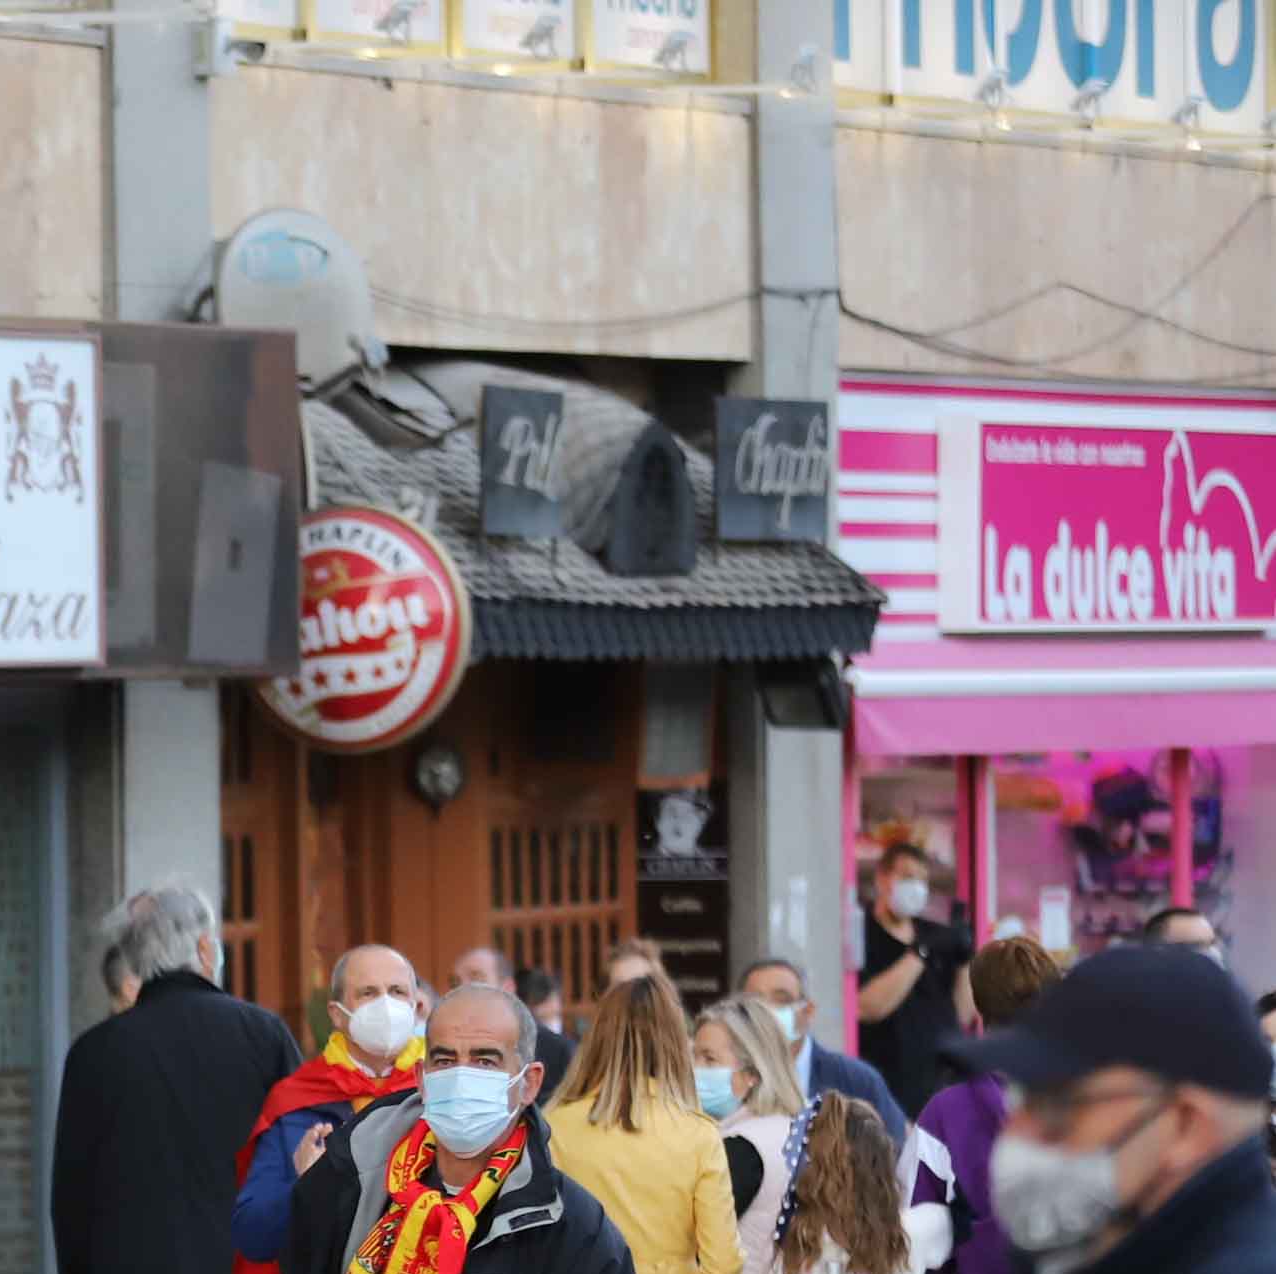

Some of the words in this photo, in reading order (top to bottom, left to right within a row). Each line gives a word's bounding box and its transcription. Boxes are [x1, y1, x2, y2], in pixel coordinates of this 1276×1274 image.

[985, 520, 1033, 621] La
[1043, 515, 1155, 621] dulce
[1161, 518, 1237, 621] vita
[301, 593, 430, 652] ahou
